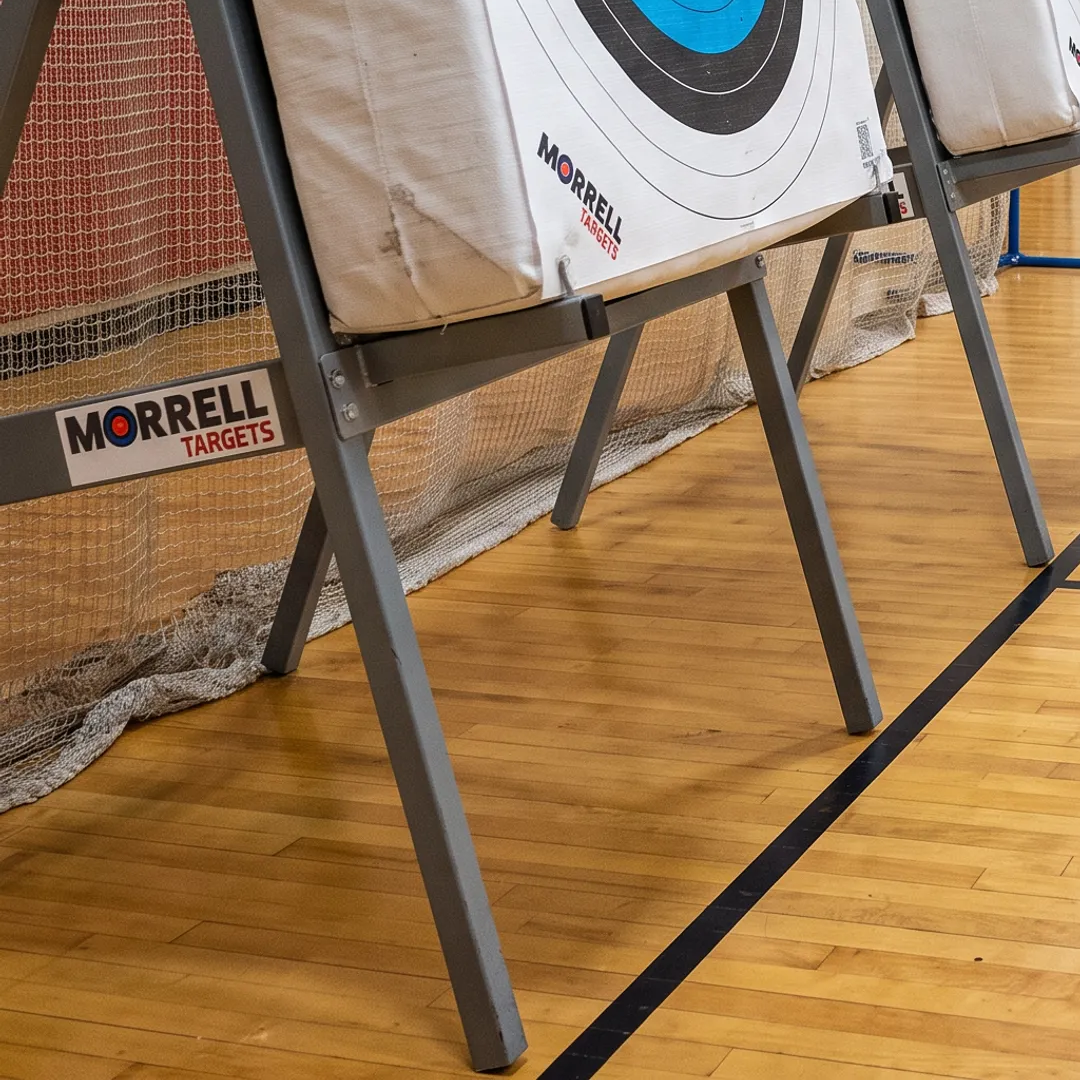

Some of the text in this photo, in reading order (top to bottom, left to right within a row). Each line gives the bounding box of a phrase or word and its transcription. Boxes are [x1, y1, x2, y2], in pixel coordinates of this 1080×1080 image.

[537, 132, 622, 245] MORRELL
[580, 207, 619, 260] TARGETS
[64, 380, 268, 454] MORRELL
[180, 420, 275, 457] TARGETS
